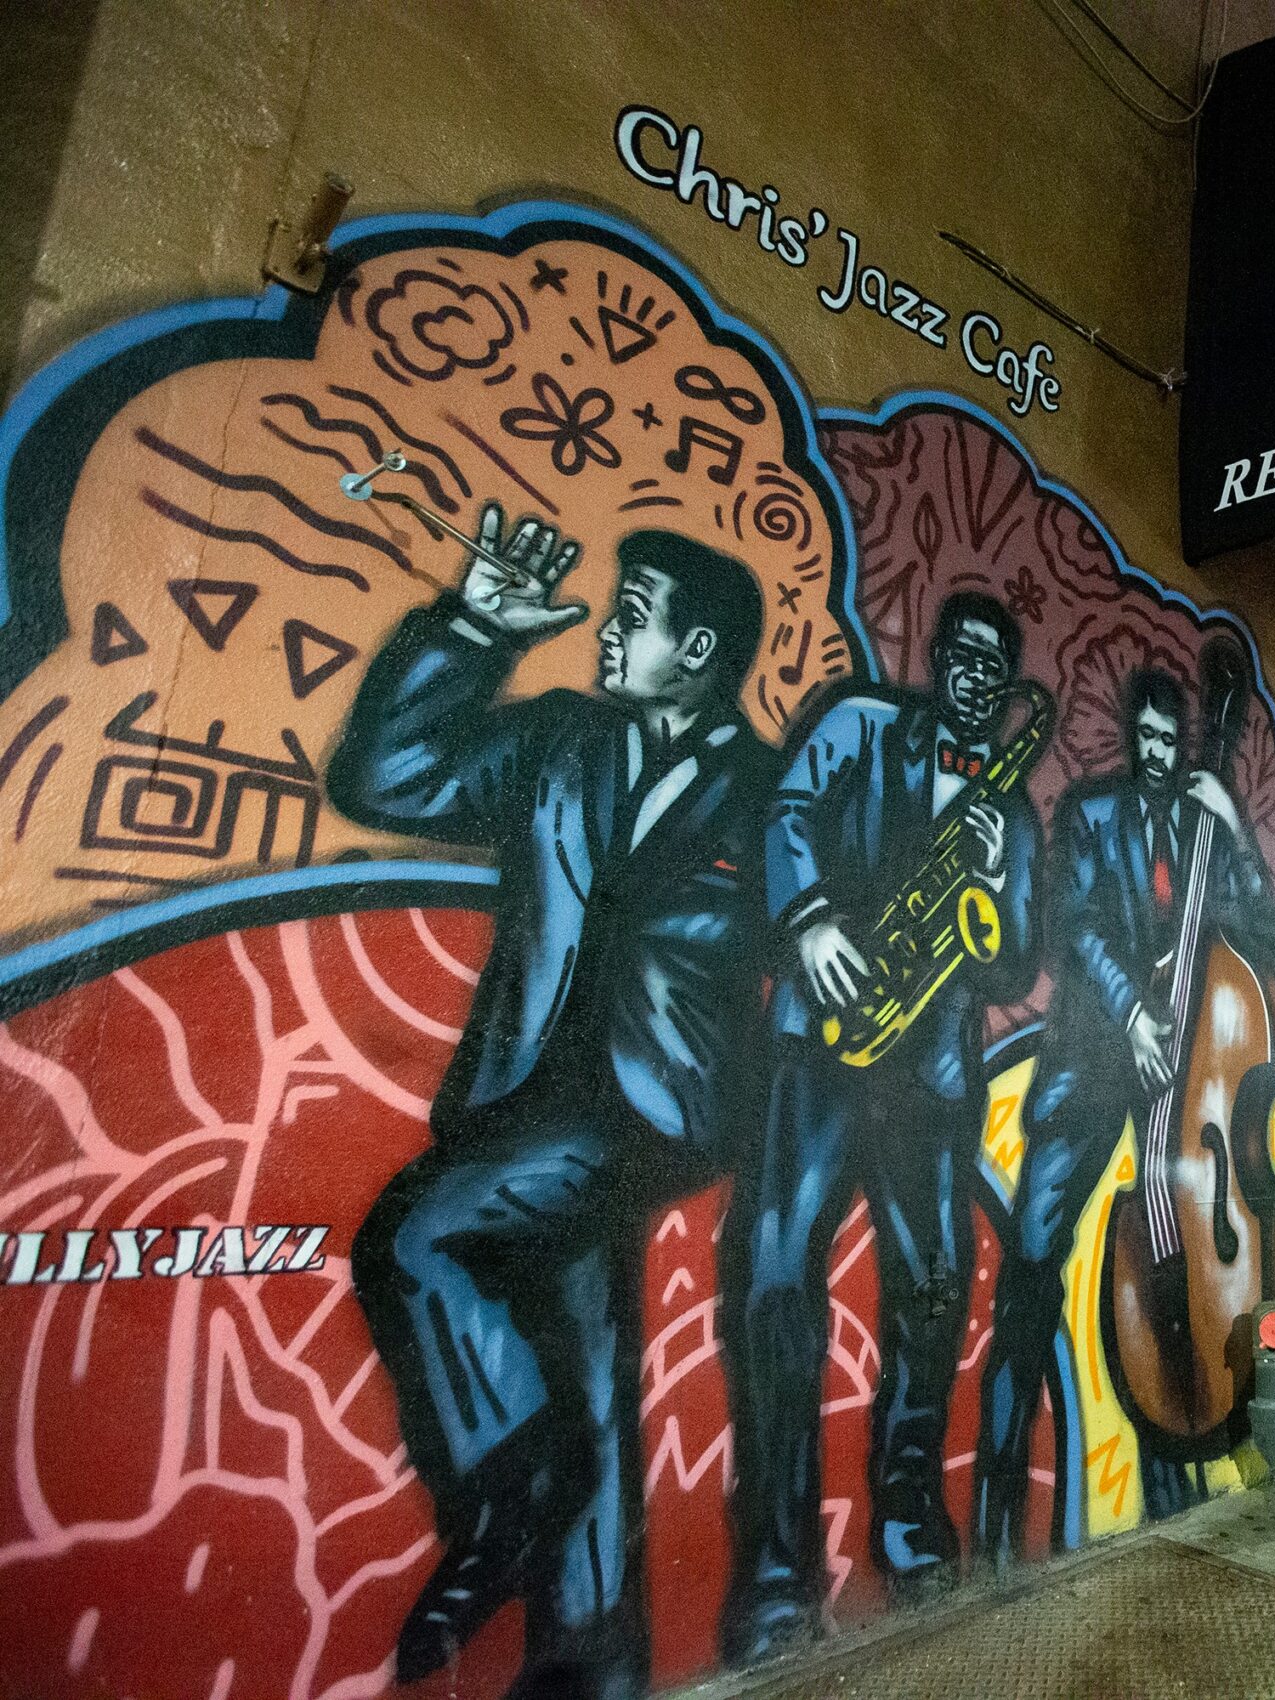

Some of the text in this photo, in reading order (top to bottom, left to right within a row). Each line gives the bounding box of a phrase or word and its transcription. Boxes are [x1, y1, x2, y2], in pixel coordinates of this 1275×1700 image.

[615, 104, 1062, 415] Chris' Jazz Cafe
[0, 1226, 330, 1285] LLYJAZZ
